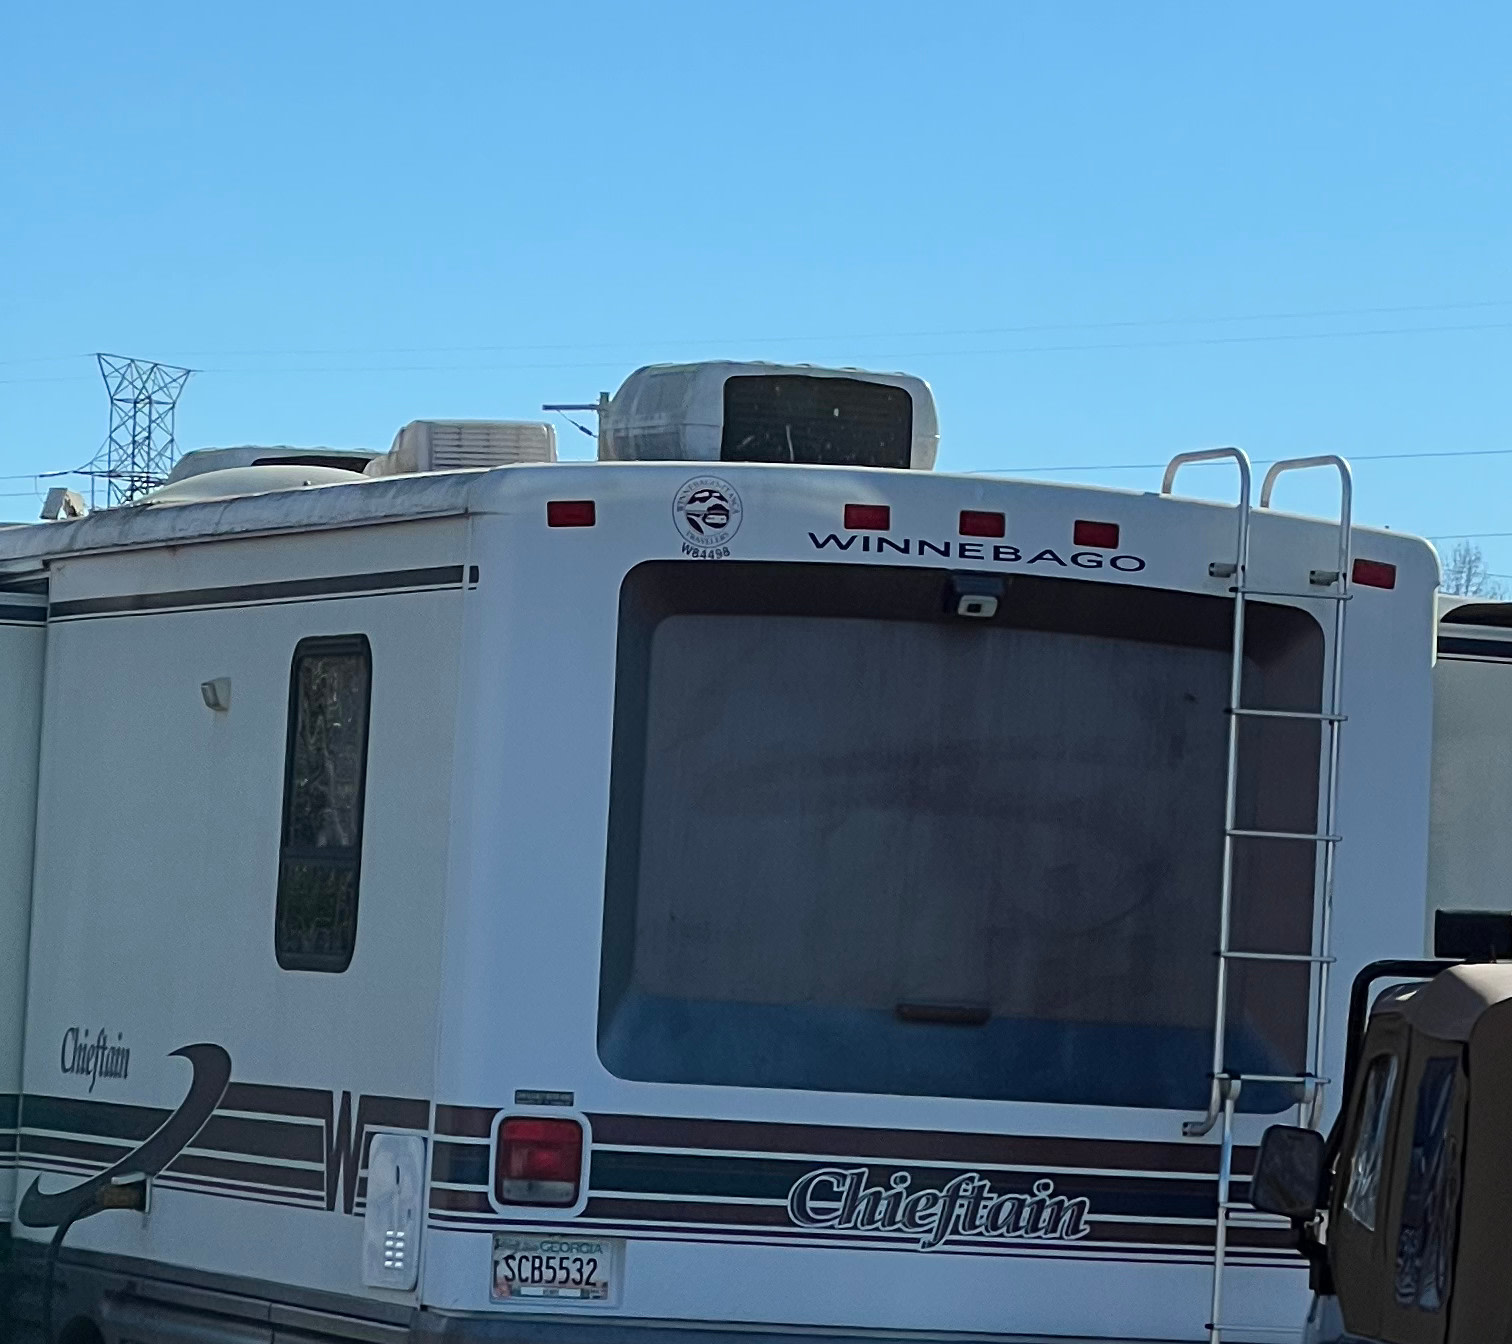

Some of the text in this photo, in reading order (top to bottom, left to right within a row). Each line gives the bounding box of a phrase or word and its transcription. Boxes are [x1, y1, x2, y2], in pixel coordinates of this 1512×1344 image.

[681, 542, 731, 560] W84498
[807, 532, 1147, 573] WINNEBAGO
[60, 1026, 130, 1094] Chieftain
[787, 1167, 1091, 1252] Chieftain
[540, 1240, 604, 1255] GEORGIA
[502, 1254, 598, 1287] SCB5532
